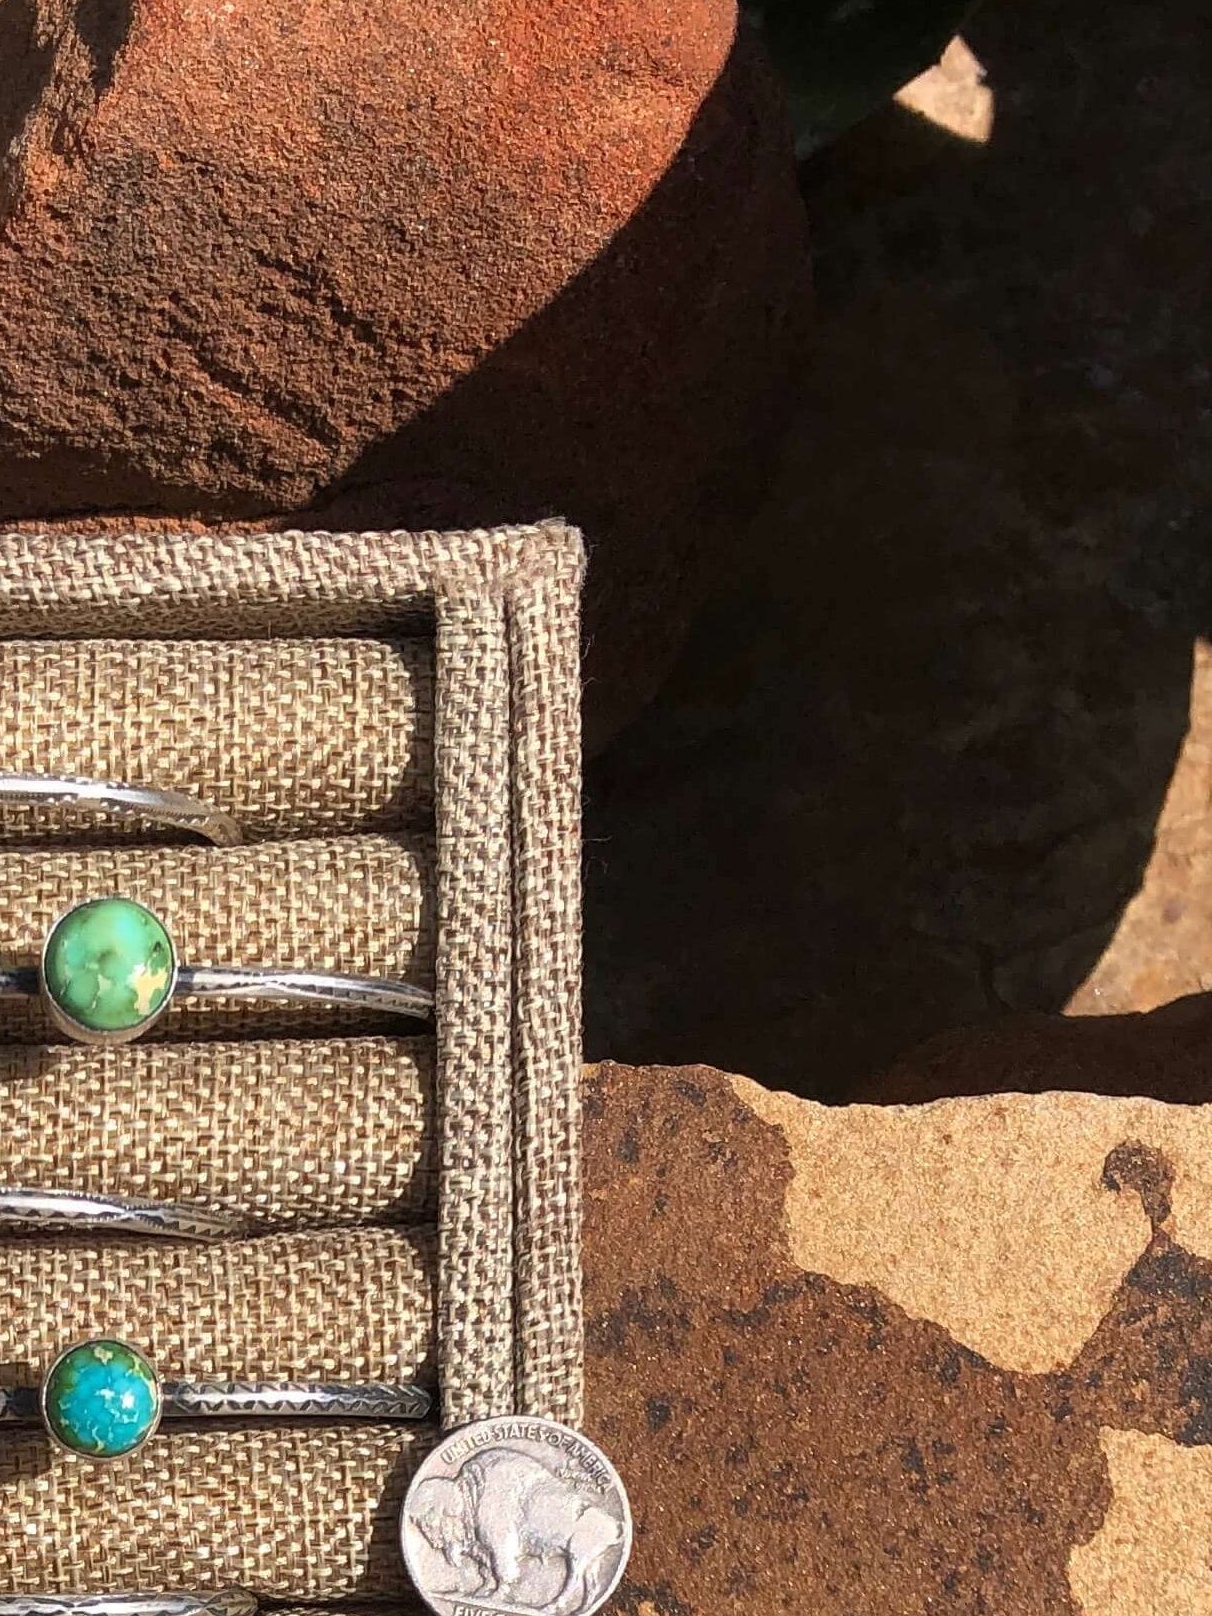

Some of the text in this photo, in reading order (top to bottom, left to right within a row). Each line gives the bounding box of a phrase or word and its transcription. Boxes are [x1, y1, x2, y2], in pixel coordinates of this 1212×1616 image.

[440, 1431, 492, 1465] UNITED
[492, 1422, 549, 1443] STATES
[547, 1432, 573, 1449] OF
[566, 1442, 614, 1492] AMERICA
